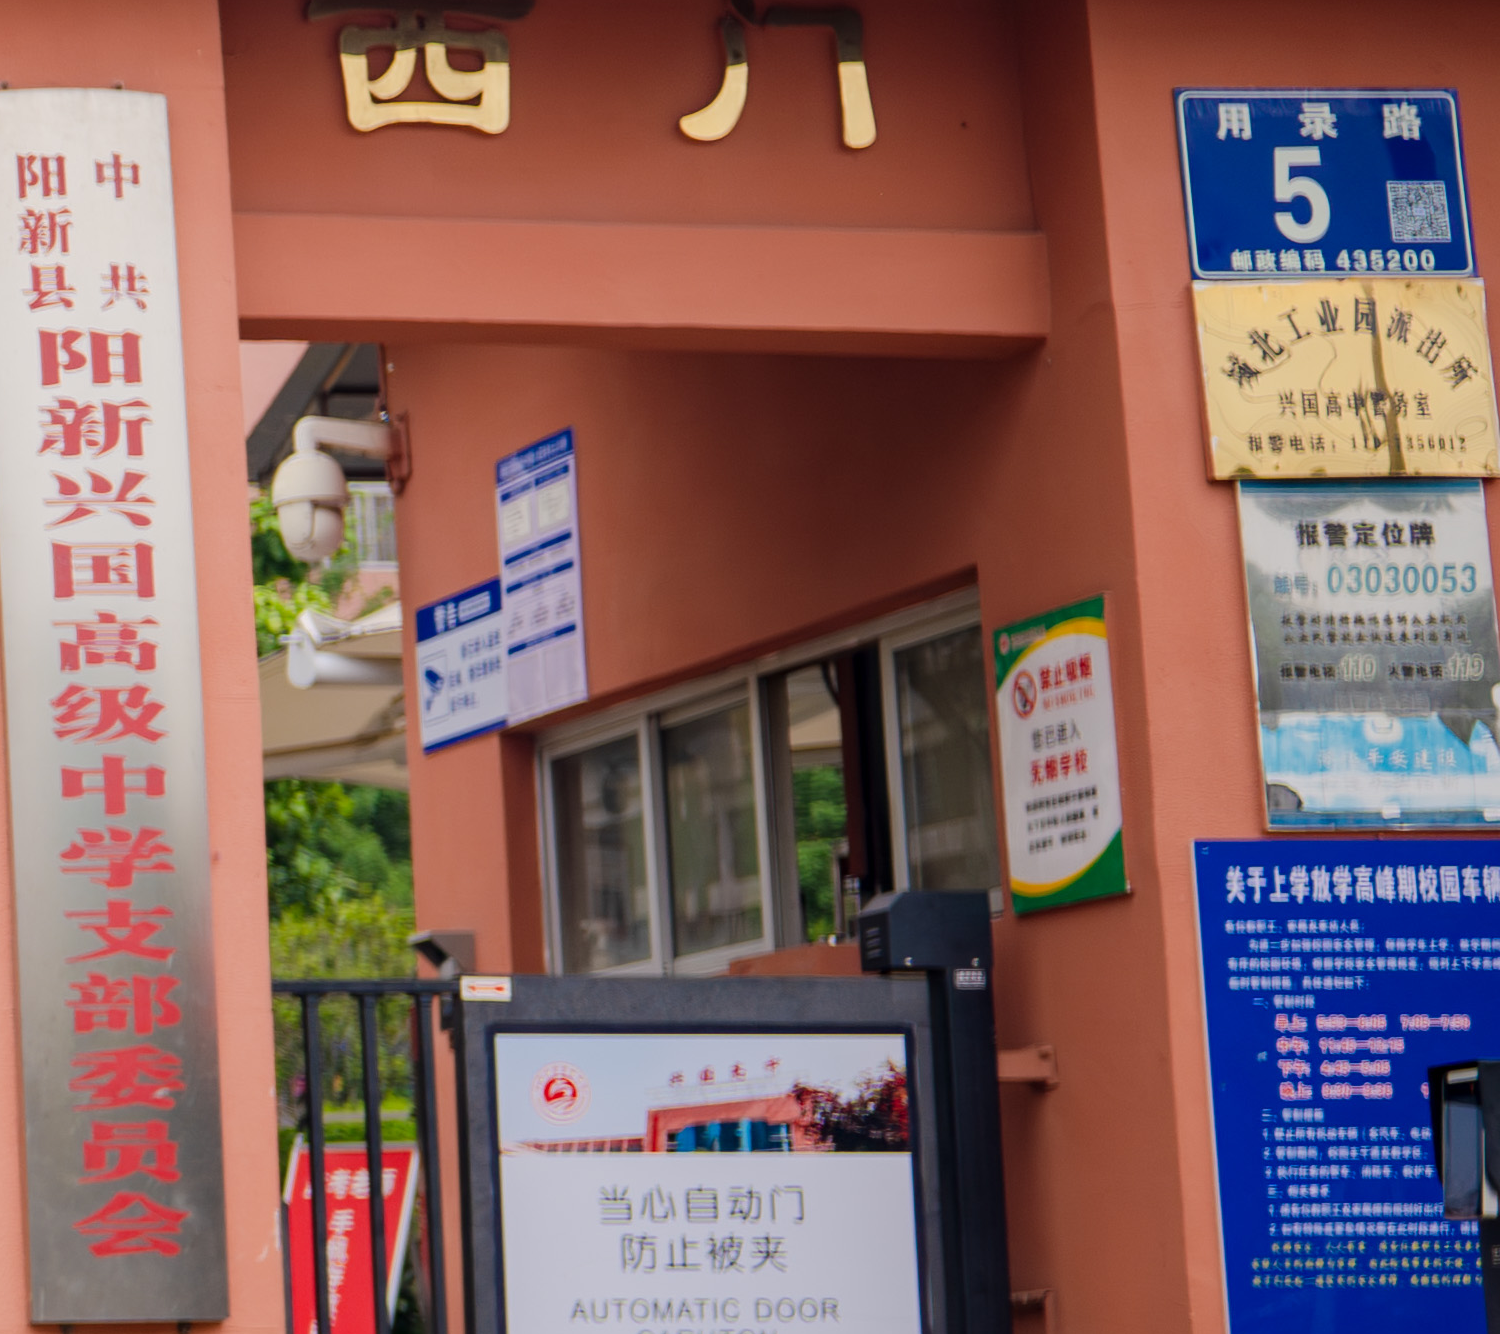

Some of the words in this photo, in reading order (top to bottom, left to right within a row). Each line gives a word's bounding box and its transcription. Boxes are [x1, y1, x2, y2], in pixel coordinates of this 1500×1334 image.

[1217, 102, 1422, 141] 用录路
[1274, 145, 1331, 244] 5
[16, 153, 75, 310] 阳新县
[1336, 249, 1436, 272] 435200
[1297, 522, 1436, 549] 报警定位牌
[1328, 562, 1478, 596] 03030053
[37, 327, 187, 1260] 阳新兴国高级中学支部委员会
[597, 1185, 806, 1224] 当心自动门
[620, 1233, 789, 1274] 防止被夹
[570, 1297, 742, 1323] AUTOMATIC
[754, 1297, 841, 1323] DOOR
